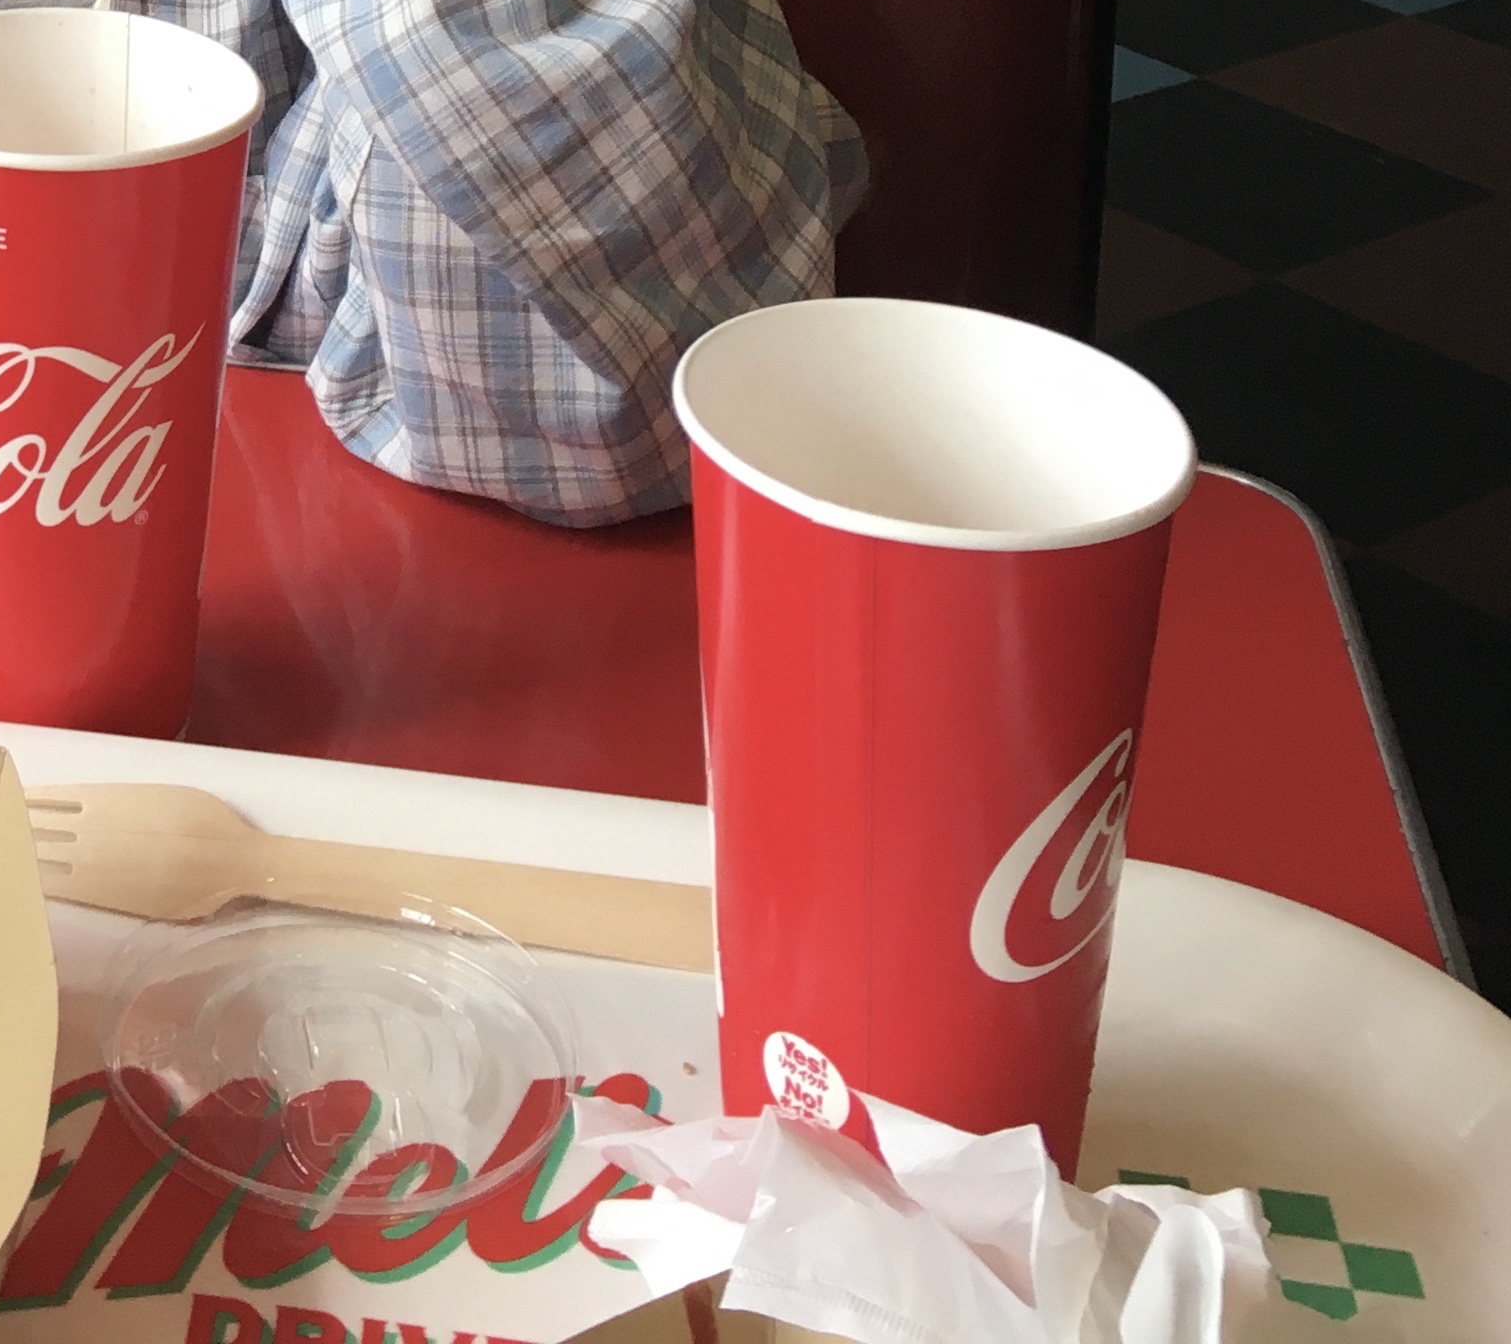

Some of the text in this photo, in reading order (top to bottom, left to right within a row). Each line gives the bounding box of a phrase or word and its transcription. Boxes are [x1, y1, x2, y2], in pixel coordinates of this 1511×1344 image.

[778, 1054, 829, 1092] リサイクル
[781, 1034, 828, 1078] Yes!
[784, 1075, 823, 1114] No!
